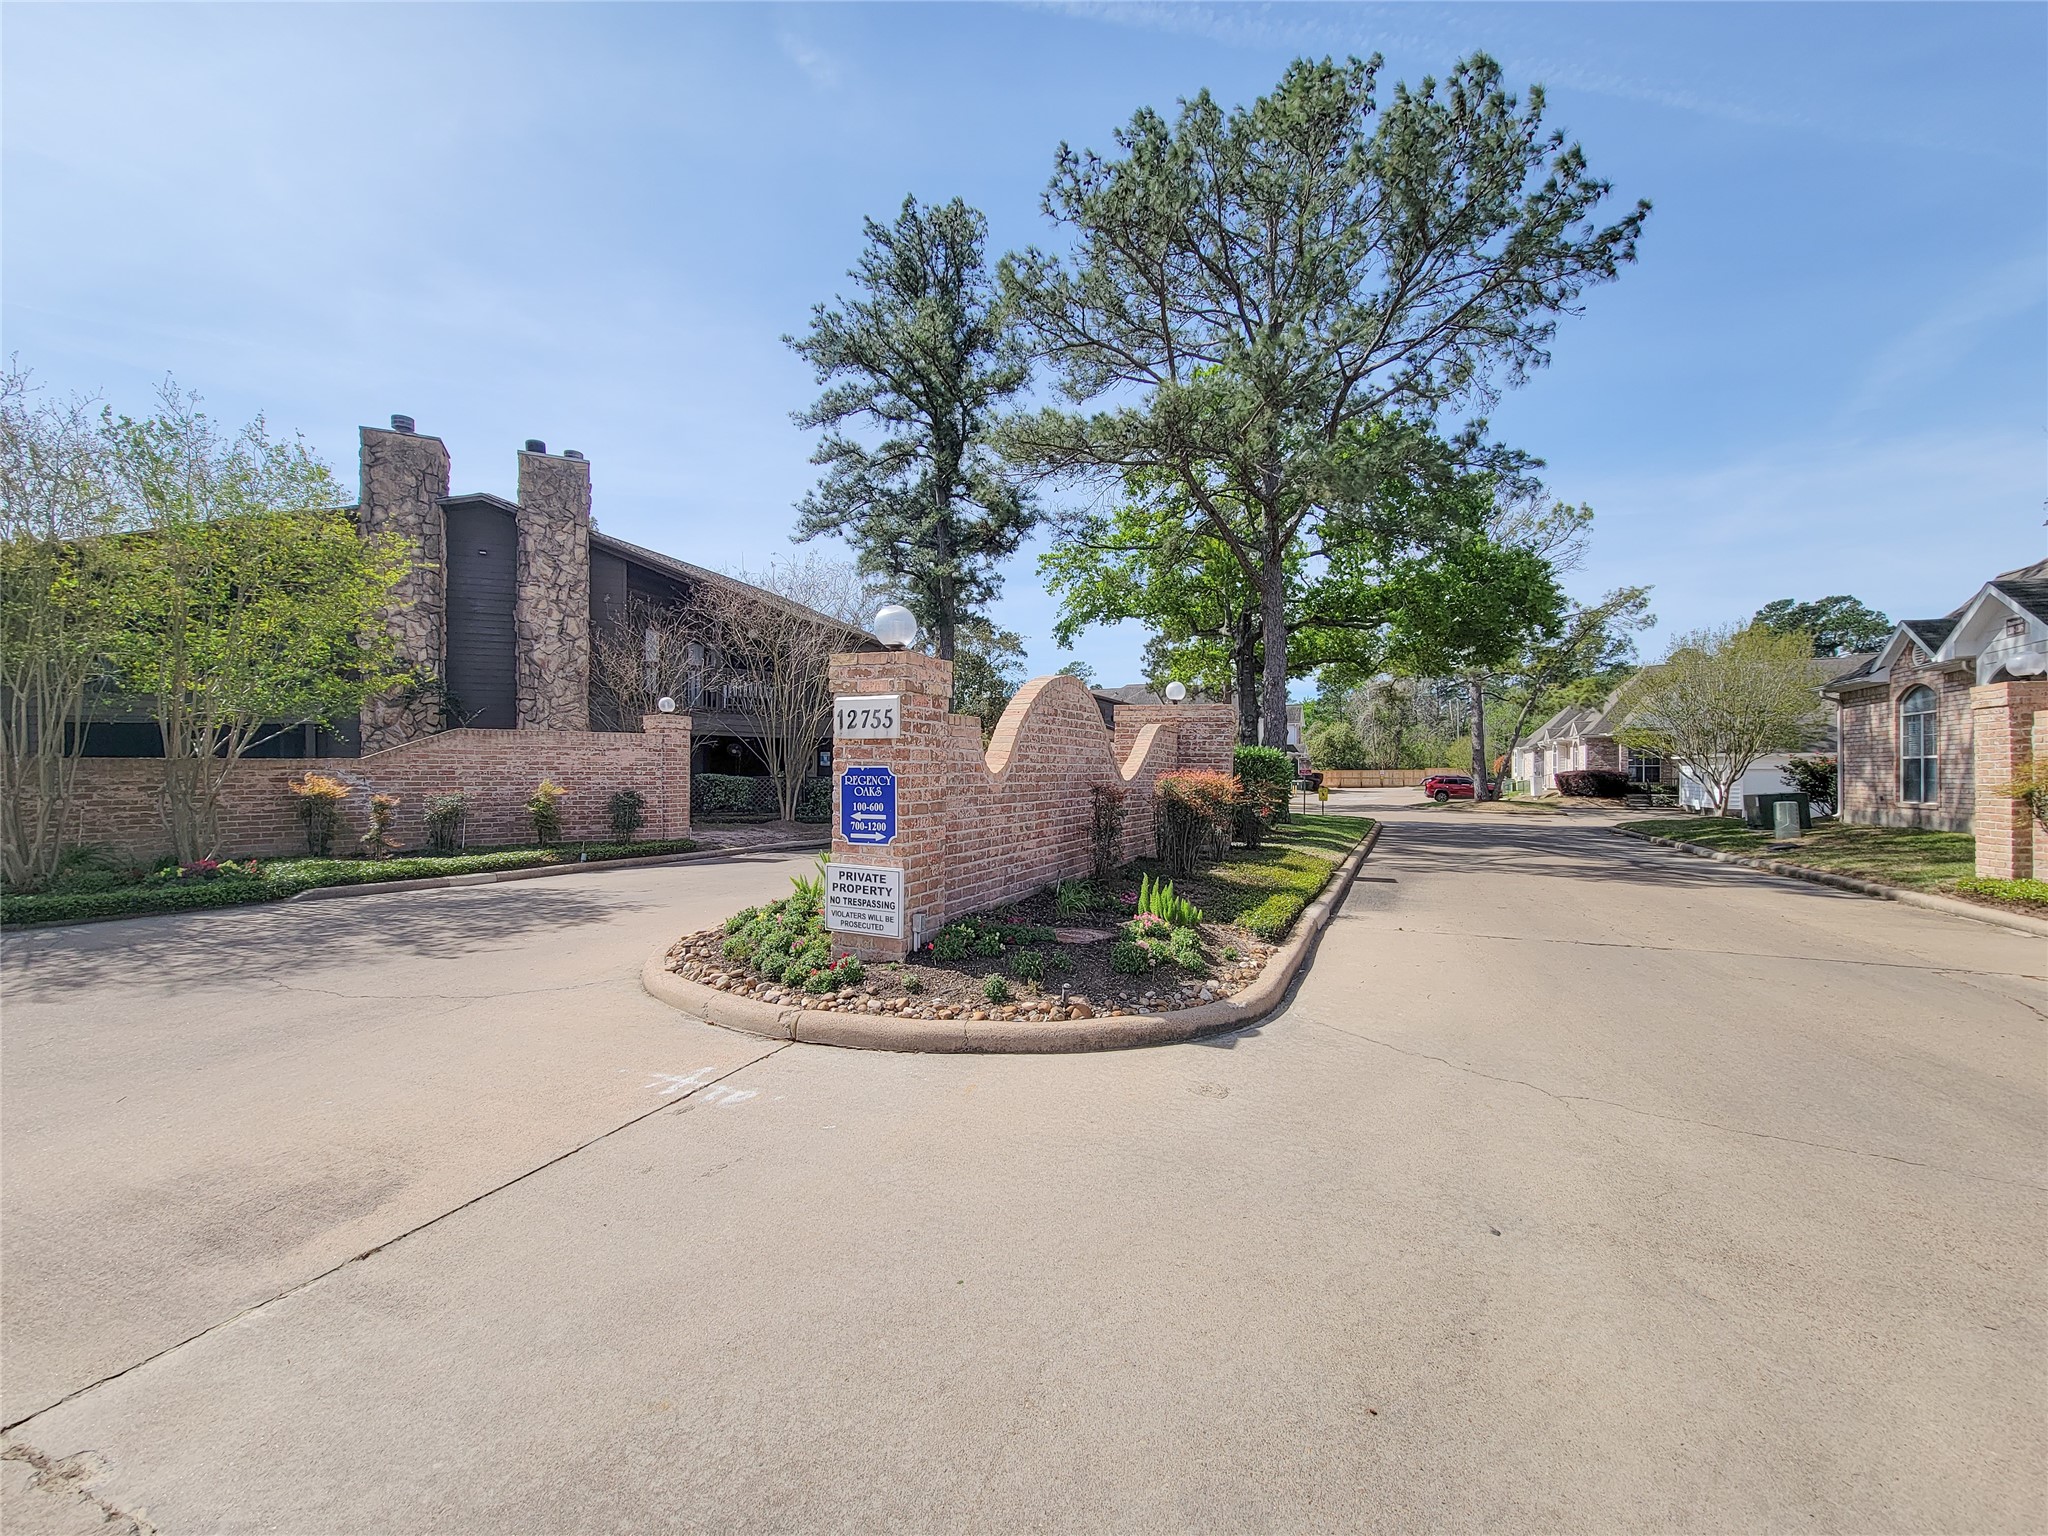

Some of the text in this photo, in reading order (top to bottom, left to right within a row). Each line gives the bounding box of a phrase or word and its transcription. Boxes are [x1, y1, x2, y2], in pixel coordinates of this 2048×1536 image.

[837, 708, 894, 730] 12755
[844, 775, 892, 786] REGENCY
[853, 786, 882, 797] OAKS
[852, 802, 884, 812] 100-600
[850, 821, 887, 832] 700-1200
[838, 870, 887, 884] PRIVATE
[832, 882, 893, 897] PROPERTY
[829, 895, 896, 911] NO TRESPASSING
[831, 909, 895, 924] VIOLATERS WILL BE
[840, 919, 884, 932] PROSECUTED
